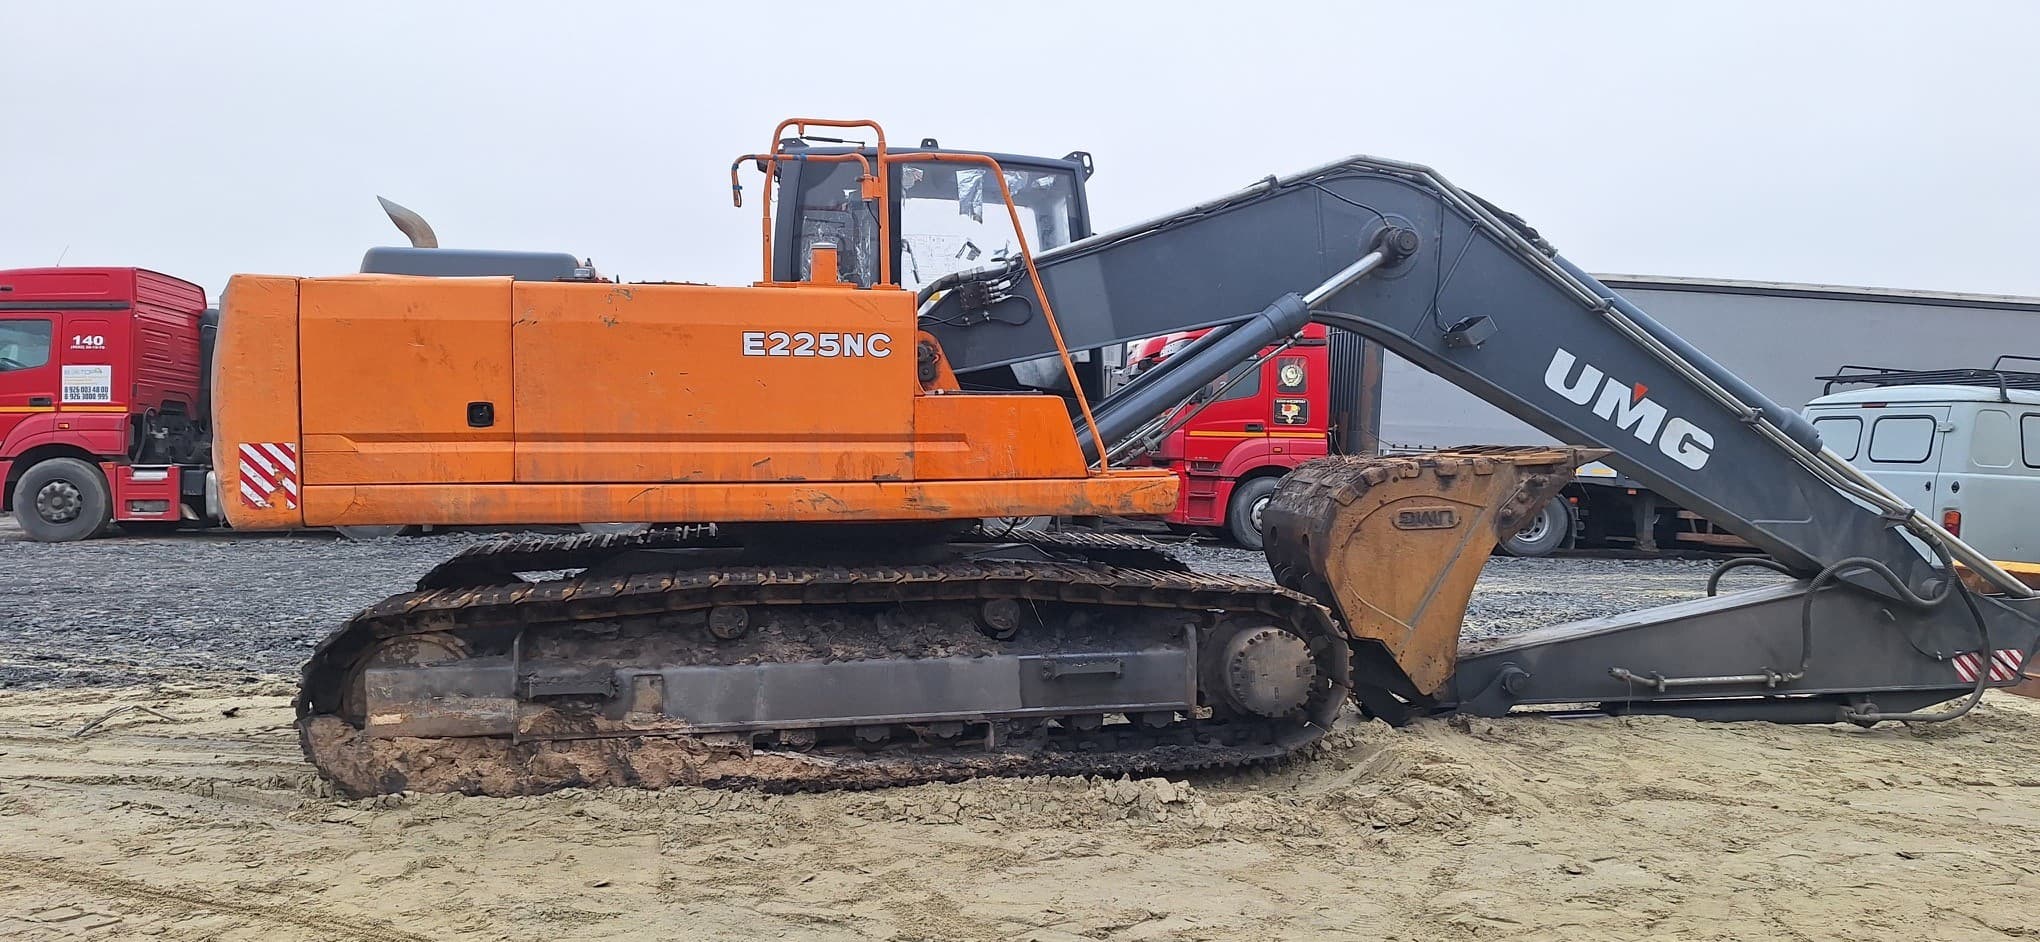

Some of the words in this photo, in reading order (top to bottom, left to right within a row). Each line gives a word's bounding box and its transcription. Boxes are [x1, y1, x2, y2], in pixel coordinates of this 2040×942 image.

[72, 335, 104, 346] 140
[742, 331, 892, 358] E225NC
[1544, 347, 1716, 471] UMG
